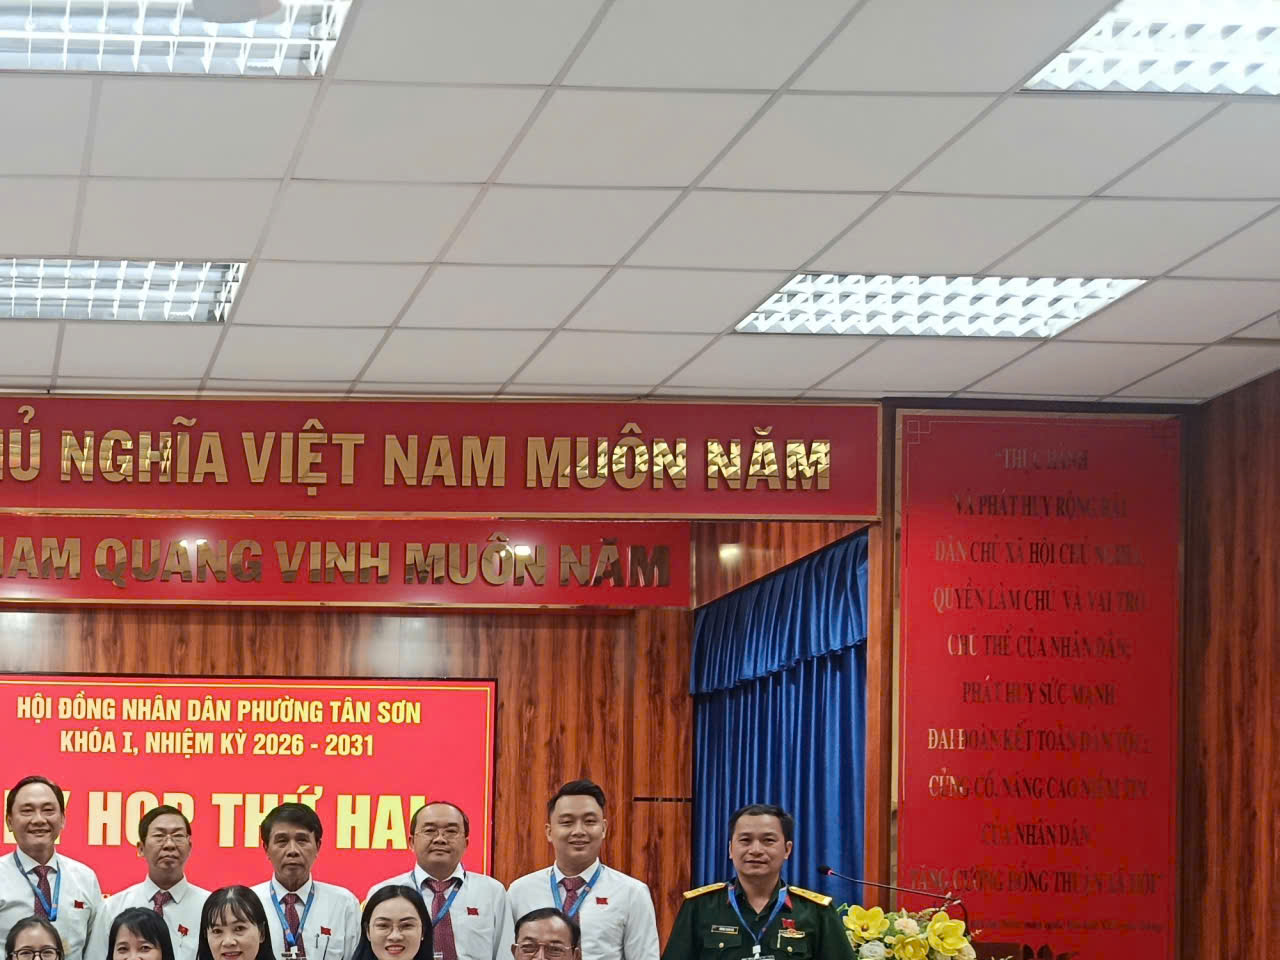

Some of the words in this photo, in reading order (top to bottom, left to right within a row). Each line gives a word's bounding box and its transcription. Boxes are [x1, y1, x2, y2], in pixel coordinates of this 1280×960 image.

[60, 415, 228, 484] NGHĨA
[241, 418, 365, 496] VIỆT
[384, 435, 506, 487] NAM
[526, 423, 687, 489] MUÔN
[707, 426, 830, 490] NĂM
[94, 538, 262, 588] QUANG
[275, 541, 390, 584] VINH
[405, 532, 547, 586] MUÔN
[560, 537, 669, 587] NĂM
[1030, 536, 1055, 567] HỘI
[17, 692, 52, 723] HỘI
[58, 690, 116, 720] ĐỒNG
[122, 694, 180, 721] NHÂN
[187, 695, 231, 722] DÂN
[237, 695, 323, 723] PHƯỜNG
[330, 697, 370, 723] TÂN
[377, 698, 421, 724] SƠN
[60, 726, 116, 753] KHÓA
[122, 731, 139, 756] I,
[145, 727, 214, 758] NHIỆM
[220, 728, 247, 755] KỲ
[253, 732, 304, 756] 2026
[325, 733, 374, 756] 2031
